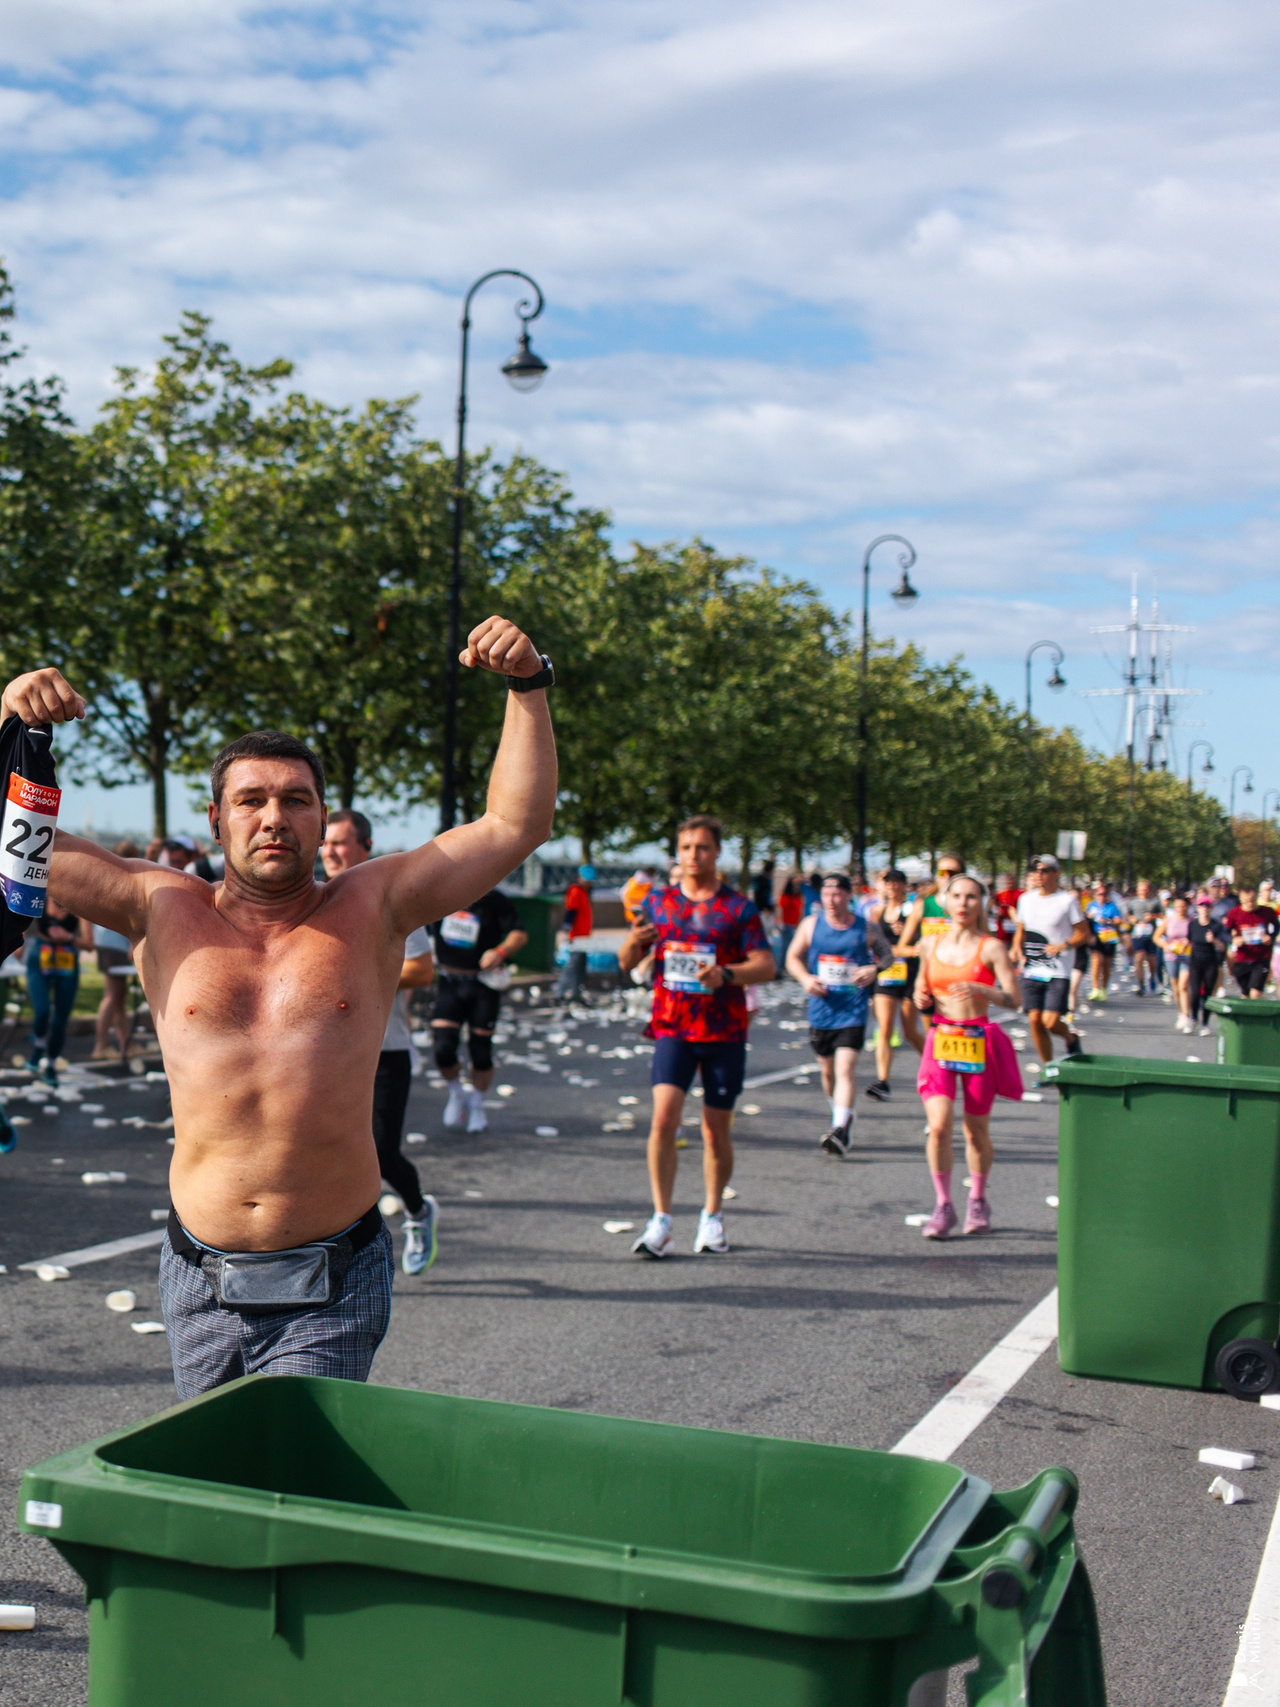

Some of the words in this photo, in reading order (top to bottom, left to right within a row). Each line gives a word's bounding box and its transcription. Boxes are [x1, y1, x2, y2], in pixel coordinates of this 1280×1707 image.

[20, 789, 57, 807] МАРАФОН
[22, 782, 43, 796] ПОЛУ
[942, 1039, 977, 1057] 6111
